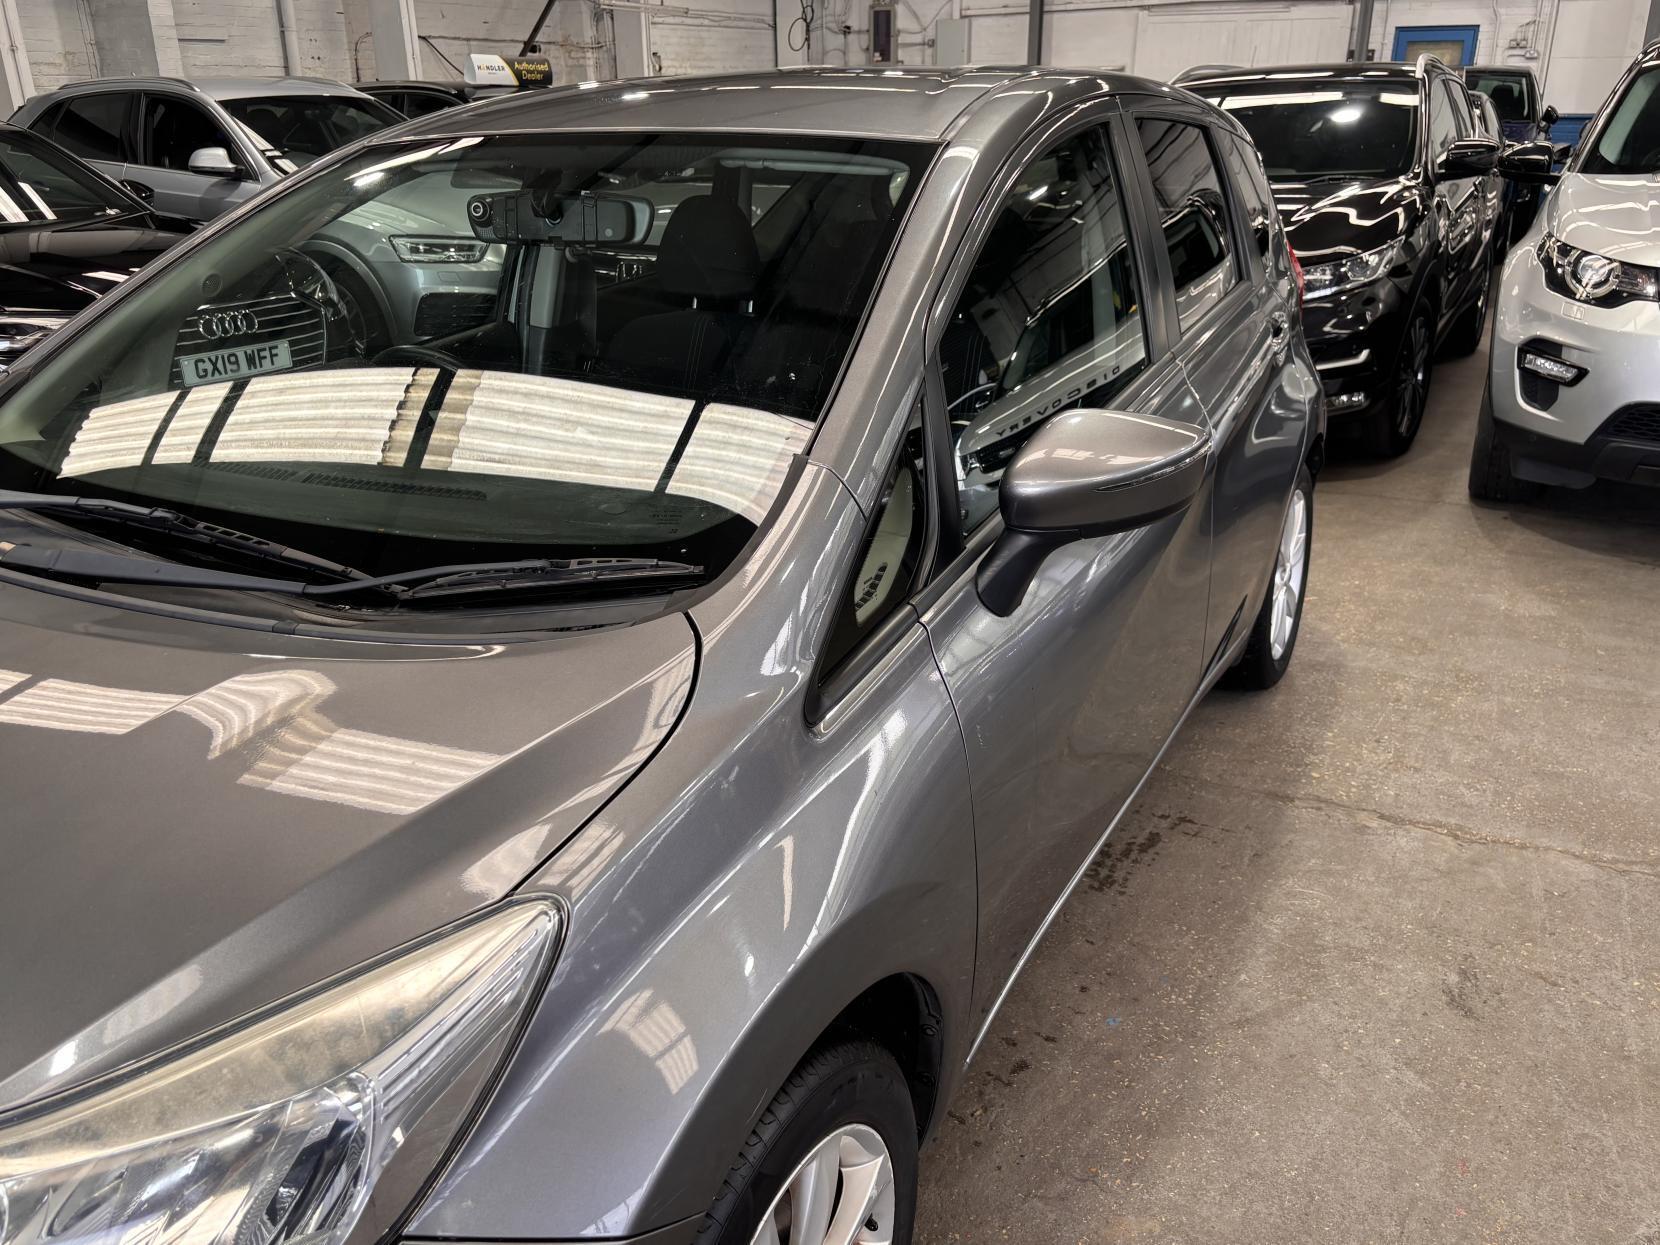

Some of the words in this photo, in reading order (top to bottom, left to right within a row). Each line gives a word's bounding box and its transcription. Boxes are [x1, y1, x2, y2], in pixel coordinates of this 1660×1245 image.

[514, 61, 549, 71] Authorised
[522, 71, 544, 80] Dealer
[194, 354, 240, 379] GX19
[244, 346, 279, 371] WFF
